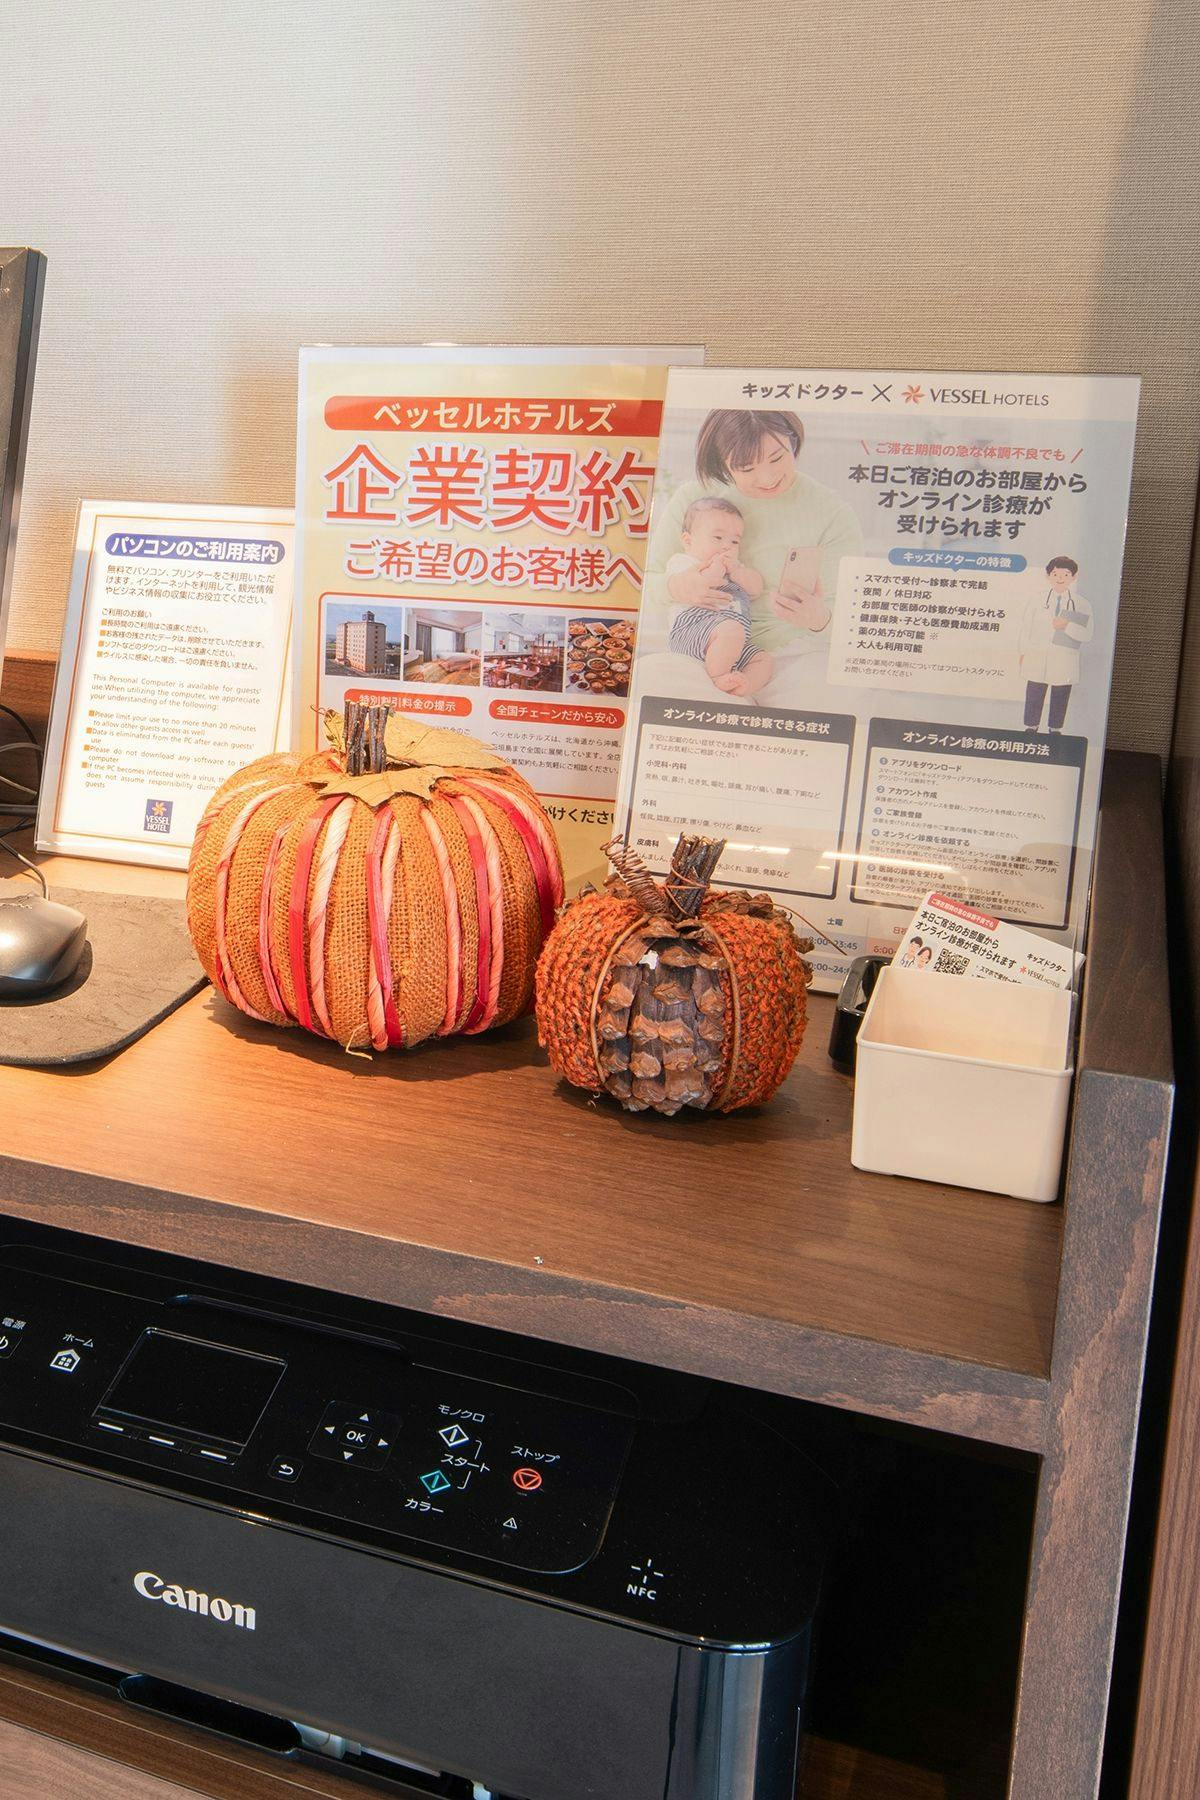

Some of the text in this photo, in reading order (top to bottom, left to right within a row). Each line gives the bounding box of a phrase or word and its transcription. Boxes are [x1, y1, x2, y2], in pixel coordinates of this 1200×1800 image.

[741, 382, 863, 400] キッズドクター
[930, 388, 991, 405] VESSEL
[993, 393, 1049, 406] HOTELS
[374, 401, 616, 434] ベッセルホテルズ
[875, 441, 1065, 462] ご滞在期間の急な体調不良でも
[324, 443, 655, 534] 企業契約
[848, 464, 1088, 493] 本日ご宿泊のお部屋から
[877, 490, 1051, 515] オンライン診療が
[896, 514, 1026, 540] 受けられます
[110, 536, 279, 563] パソコンのご利用案内
[346, 539, 642, 588] ご希望のお客様へ
[903, 551, 1012, 569] キッズドクターの特徴
[863, 587, 882, 596] 夜間
[894, 589, 932, 599] 休日対応
[861, 601, 1006, 619] お部屋で医師の診察が受けられる
[858, 626, 925, 640] 薬の処方が可能
[857, 640, 923, 653] 大人も利用可能
[496, 704, 618, 724] 全国チェーンだから安心
[663, 707, 831, 735] オンライン診療で診察できる症状
[902, 731, 1050, 756] オンライン診療の利用方法
[646, 759, 687, 770] 小児科・内科
[891, 758, 962, 772] アプリをダウンロード
[642, 798, 657, 808] 外科
[888, 787, 937, 800] アカウント作成
[826, 918, 843, 926] 土曜
[920, 910, 1000, 948] 本日ご宿泊のお部屋から
[915, 921, 1017, 969] オンライン診療が受けられます
[1027, 953, 1067, 973] キッズドクター
[1, 1316, 27, 1330] 電源
[62, 1332, 95, 1349] ホーム
[437, 1403, 486, 1423] モノクロ
[346, 1429, 366, 1444] OK
[441, 1453, 490, 1473] スタート
[510, 1445, 561, 1464] ストップ
[404, 1497, 444, 1514] カラー
[133, 1571, 257, 1631] Canon
[626, 1583, 657, 1600] NFC
